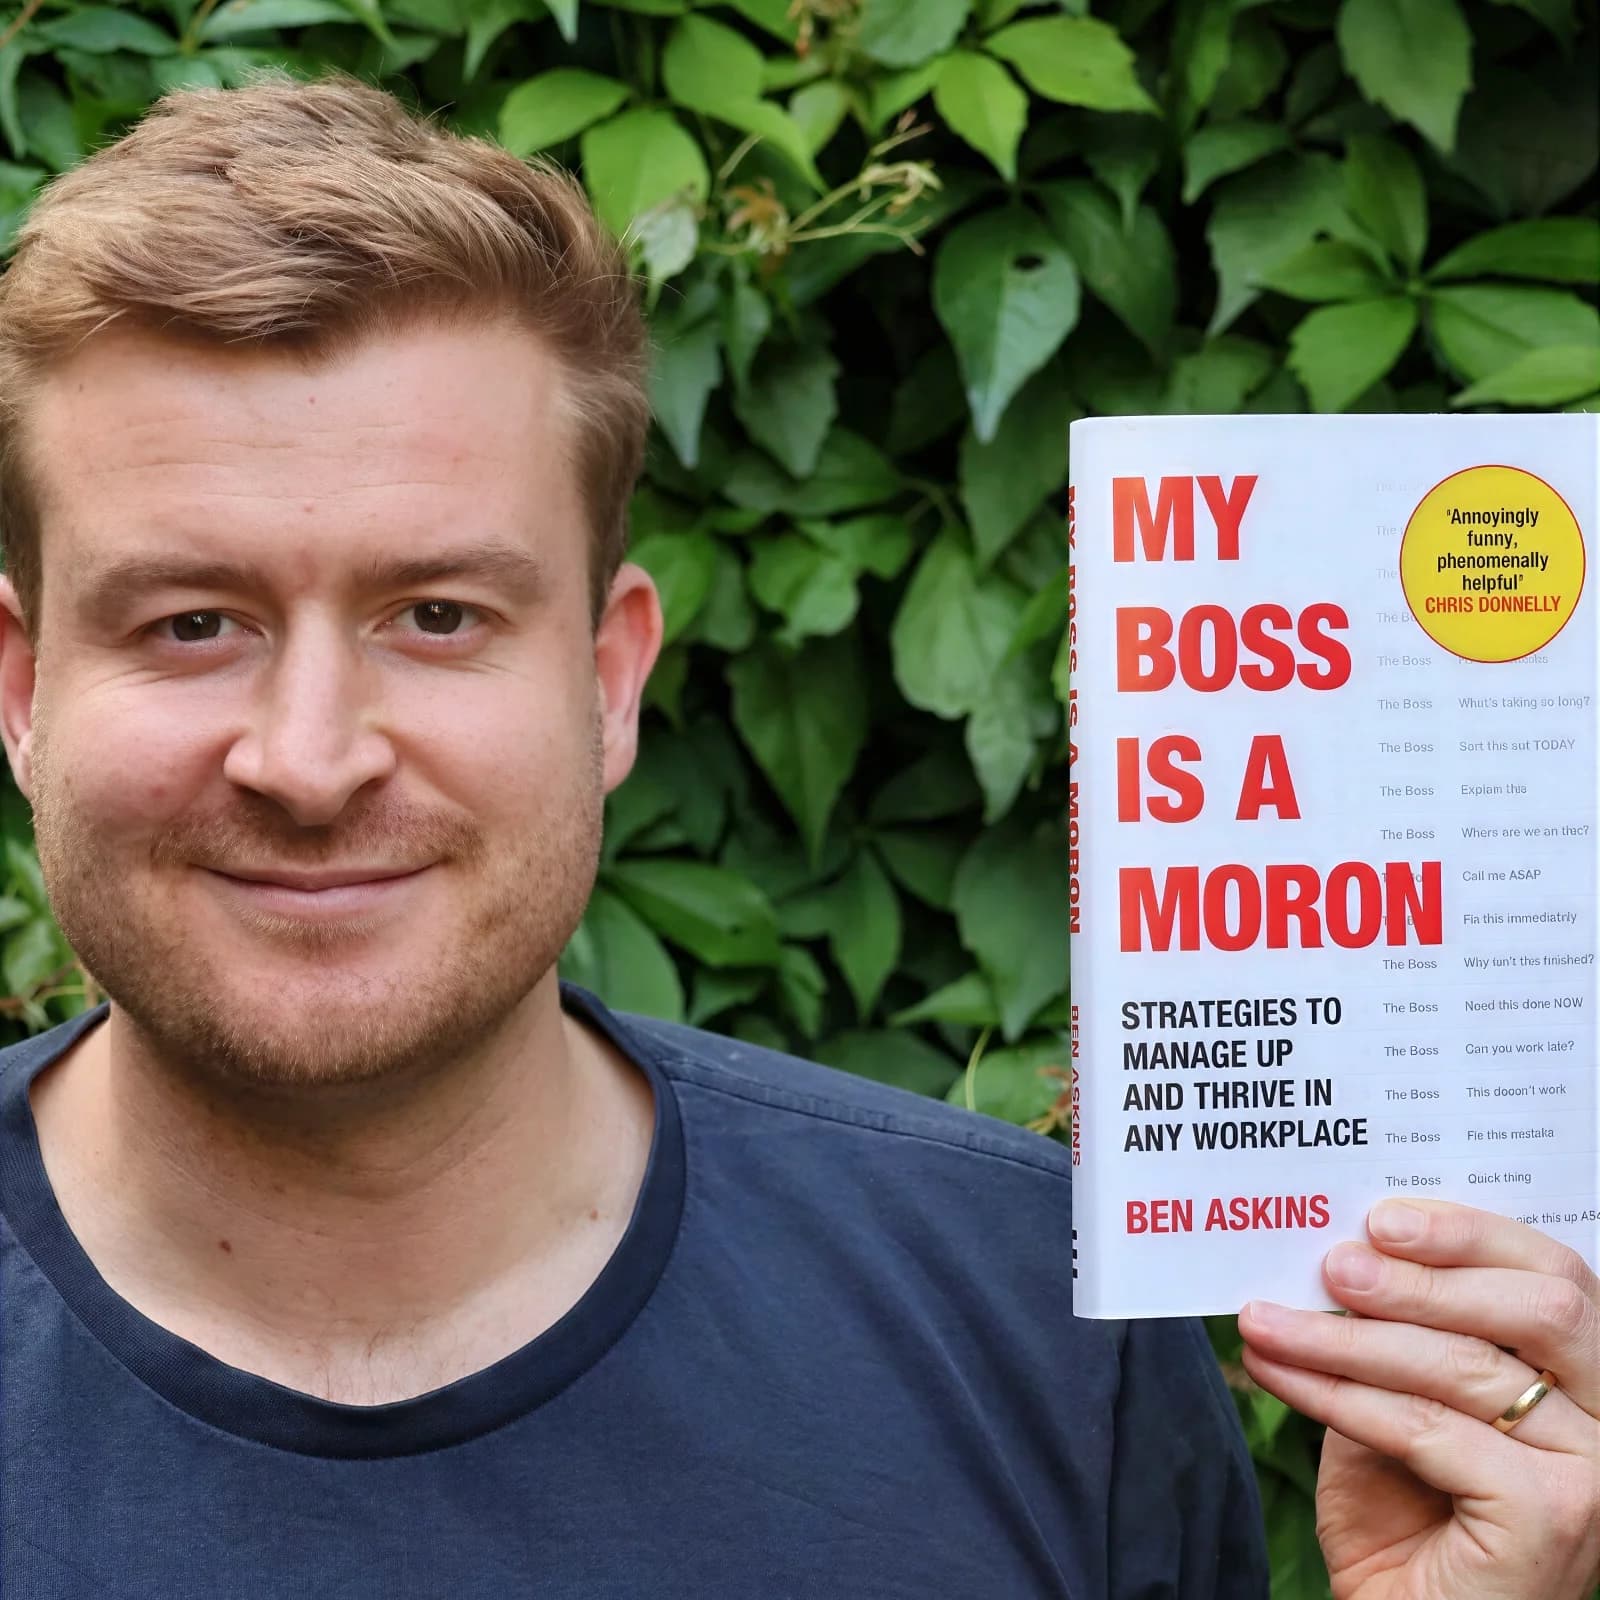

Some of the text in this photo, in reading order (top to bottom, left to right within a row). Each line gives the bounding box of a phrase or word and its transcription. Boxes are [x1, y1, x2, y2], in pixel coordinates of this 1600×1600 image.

[1113, 475, 1258, 562] MY
[1467, 530, 1519, 549] funny,
[1437, 552, 1550, 573] phenomenally
[1425, 596, 1561, 614] CHRIS DONNELLY
[1115, 602, 1352, 692] BOSS
[1376, 698, 1433, 711] The Boss
[1558, 696, 1591, 709] long?
[1377, 741, 1435, 753] The Boss
[1533, 739, 1575, 751] TODAY
[1117, 735, 1301, 823] IS A
[1380, 784, 1435, 797] The Boss
[1379, 828, 1436, 841] The Boss
[1522, 825, 1542, 837] we
[1462, 868, 1542, 882] Call me ASAP
[1119, 861, 1443, 952] MORON
[1482, 912, 1505, 925] this
[1382, 958, 1438, 971] The Boss
[1464, 957, 1489, 969] Why
[1382, 1001, 1439, 1014] The Boss
[1553, 997, 1584, 1009] NOW
[1121, 997, 1343, 1030] STRATEGIES TO
[1383, 1045, 1439, 1057] The Boss
[1465, 1039, 1575, 1056] Can you work late?
[1122, 1039, 1294, 1071] MANAGE UP
[1123, 1078, 1334, 1112] AND THRIVE IN
[1384, 1088, 1440, 1101] The Boss
[1465, 1086, 1491, 1098] This
[1539, 1084, 1566, 1096] work
[1123, 1118, 1369, 1153] ANY WORKPLACE
[1384, 1132, 1441, 1144] The Boss
[1384, 1175, 1441, 1188] The Boss
[1467, 1172, 1532, 1185] Quick thing
[1125, 1195, 1331, 1235] BEN ASKINS
[1541, 1210, 1562, 1225] this
[1563, 1211, 1578, 1227] up
